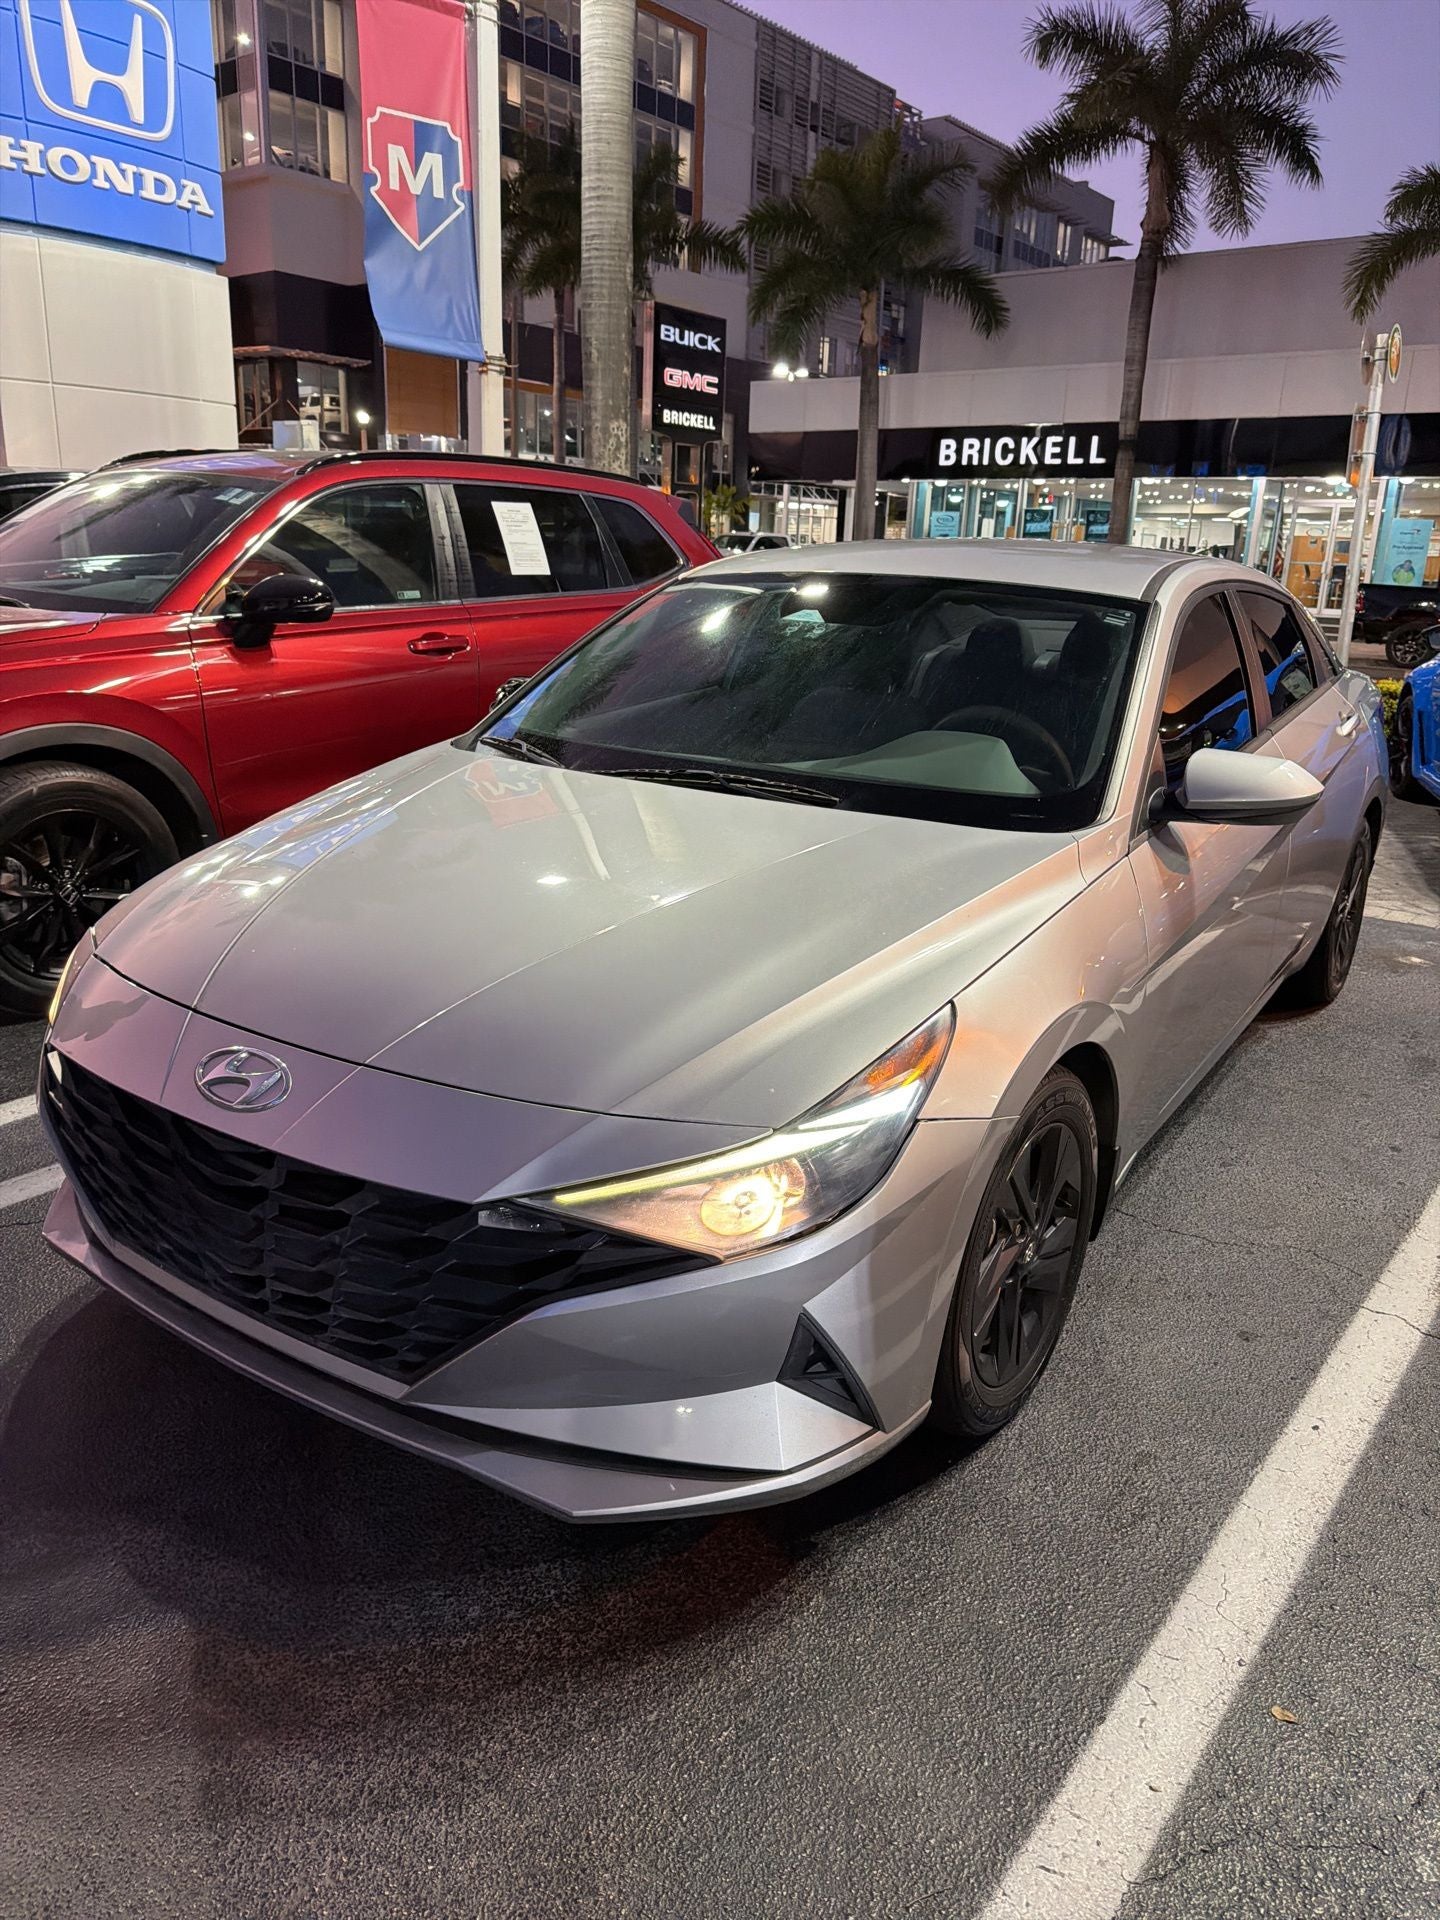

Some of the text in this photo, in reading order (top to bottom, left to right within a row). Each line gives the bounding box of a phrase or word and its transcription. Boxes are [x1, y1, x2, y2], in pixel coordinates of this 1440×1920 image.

[0, 134, 214, 218] HONDA
[387, 143, 444, 199] M
[660, 323, 722, 353] BUICK
[663, 367, 719, 395] GMC
[662, 408, 716, 430] BRICKELL
[938, 435, 1107, 466] BRICKELL
